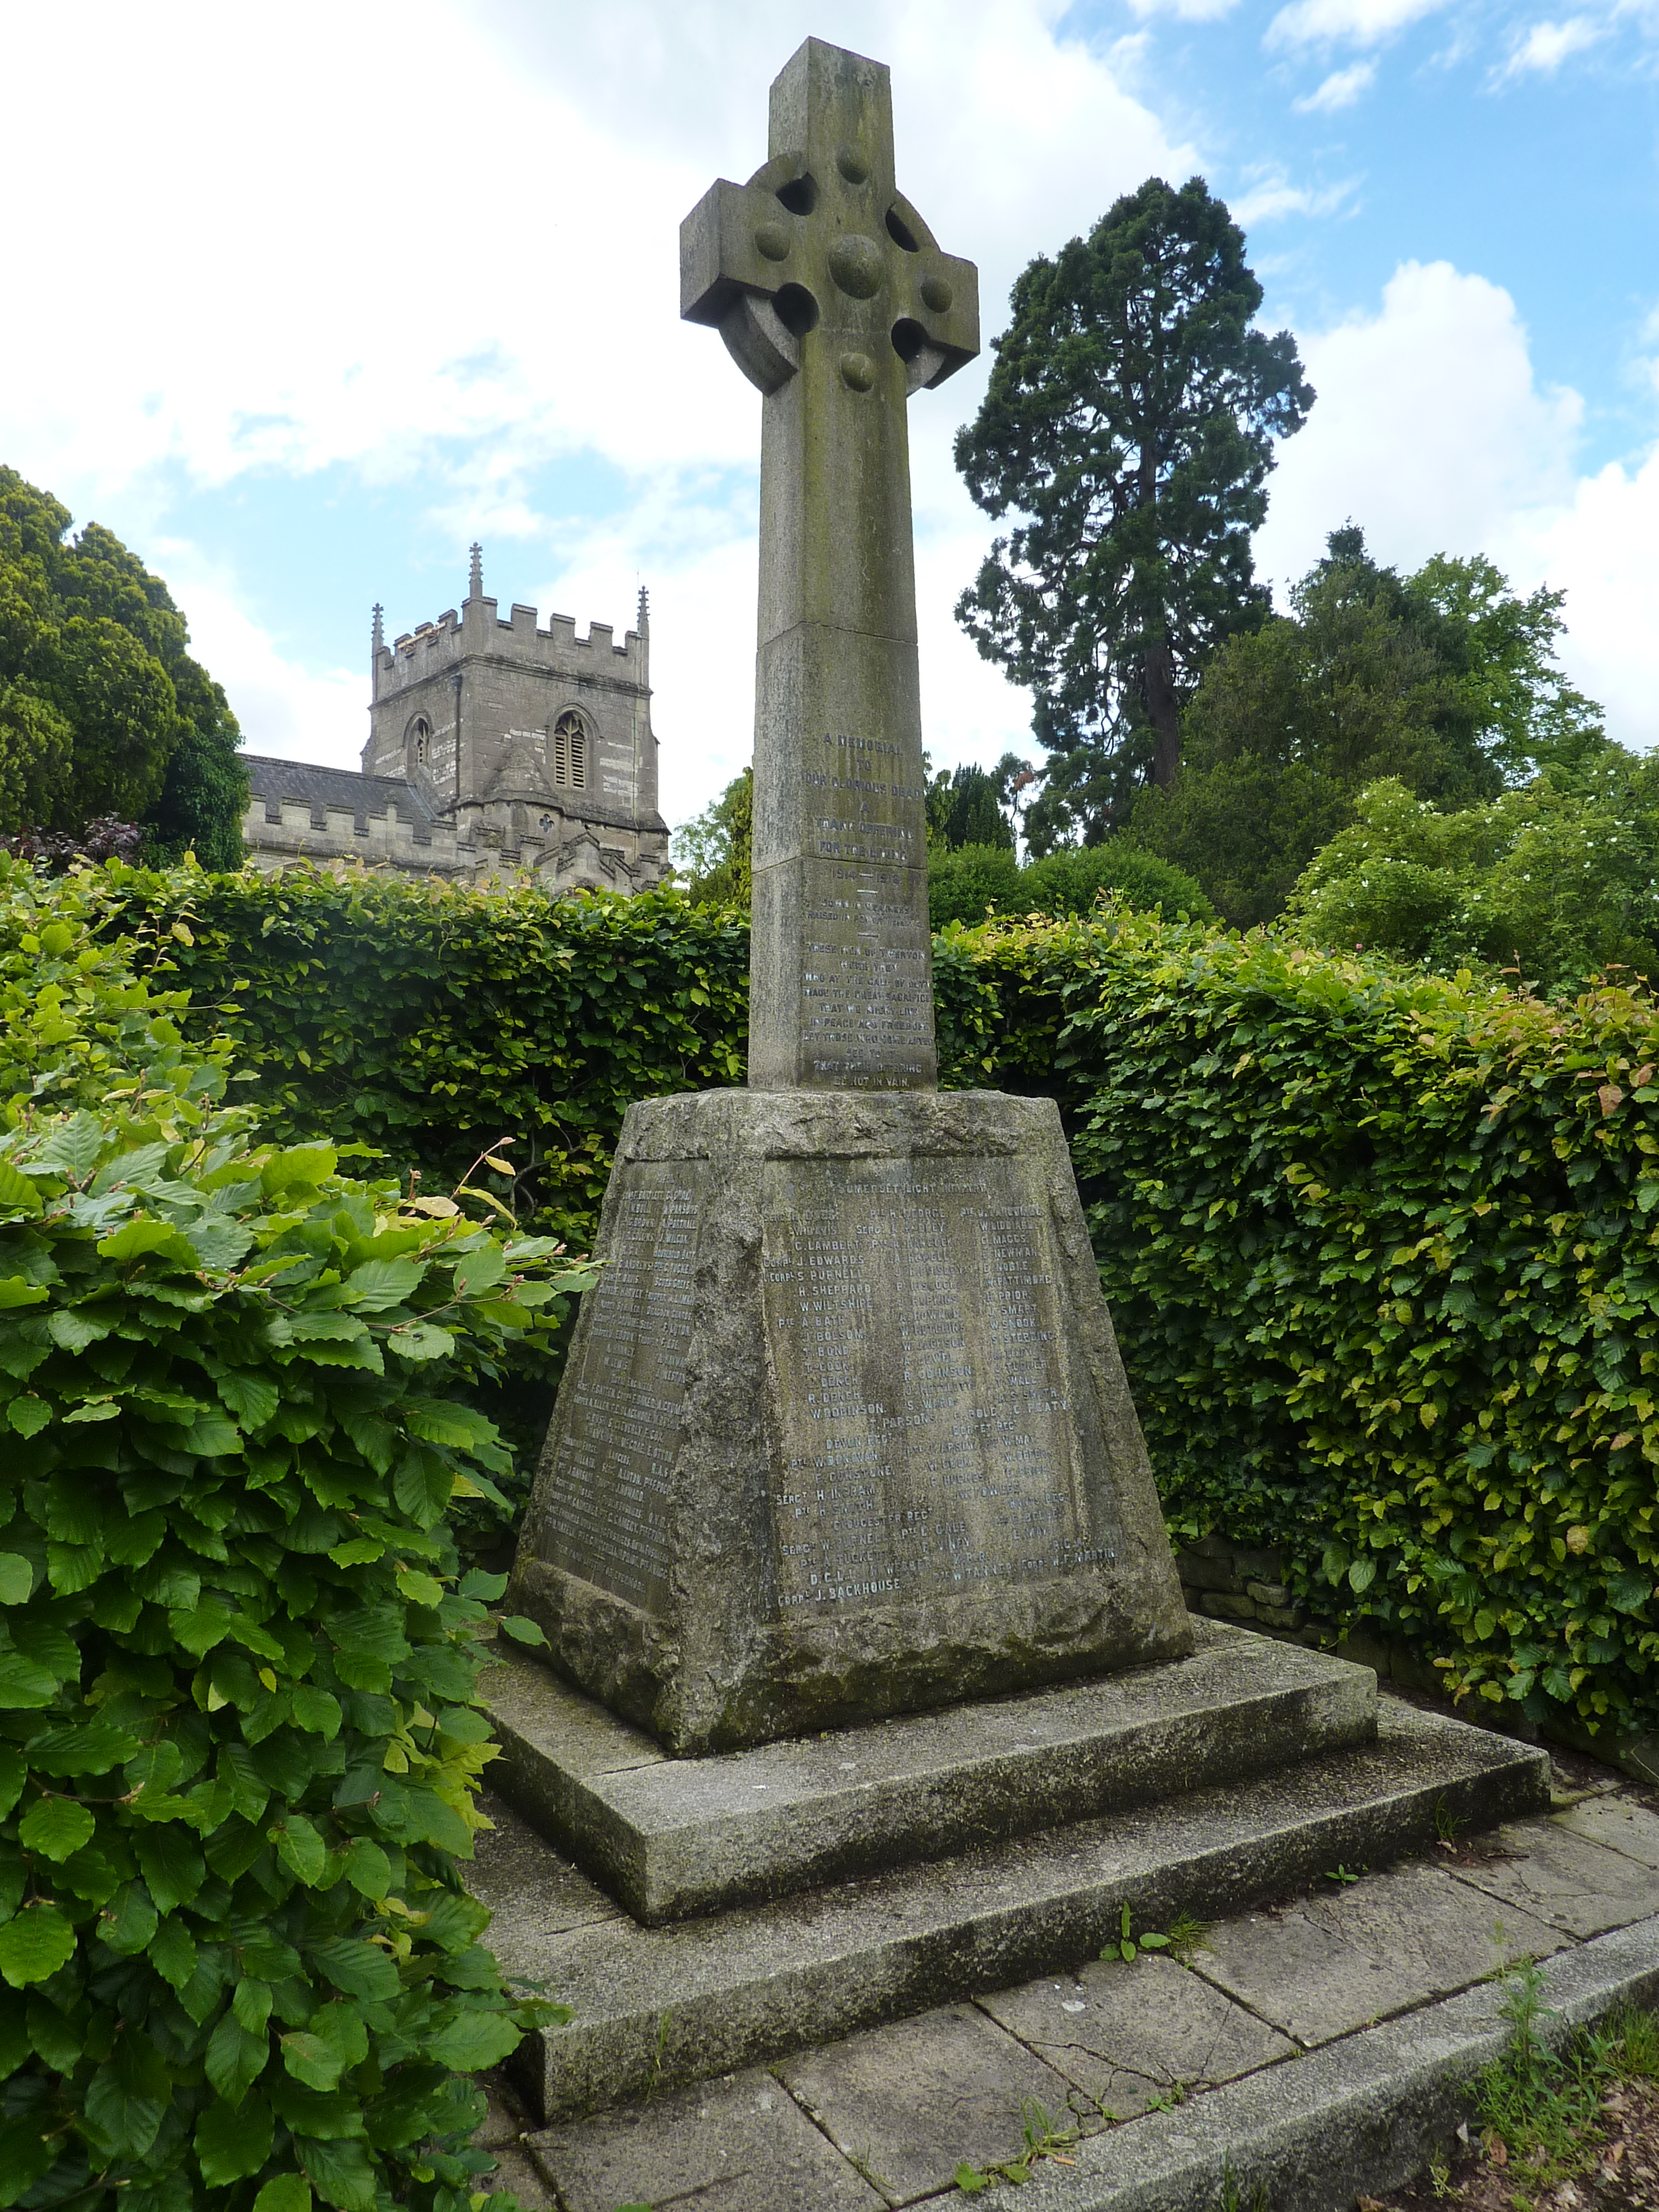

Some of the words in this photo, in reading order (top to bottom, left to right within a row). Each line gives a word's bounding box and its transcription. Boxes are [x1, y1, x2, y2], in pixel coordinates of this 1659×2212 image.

[838, 734, 903, 756] MEMORIAL
[806, 773, 826, 786] OUR
[832, 776, 886, 794] GLORIOUS
[892, 785, 920, 798] DEAD
[860, 821, 913, 839] OFFERING
[819, 841, 840, 853] FOR
[845, 843, 865, 856] THE
[808, 910, 838, 920] RAISED
[806, 943, 836, 954] THESE
[880, 947, 925, 960] TWERTON
[873, 962, 899, 972] THEY
[805, 973, 824, 982] WHO
[846, 976, 863, 985] THE
[833, 989, 850, 998] THE
[855, 990, 882, 1000] GREAT
[886, 991, 930, 1002] SACRIFICE
[819, 1002, 843, 1013] THAT
[824, 1017, 854, 1028] PEACE
[823, 1032, 853, 1042] THOSE
[814, 1060, 839, 1071] THAT
[851, 1077, 869, 1086] NOT
[808, 1241, 860, 1250] LAMBERT
[994, 1247, 1037, 1258] NEWMAN
[809, 1256, 864, 1266] EDWARDS
[811, 1270, 863, 1281] PURNELL
[813, 1284, 871, 1296] SHEPPARD
[813, 1299, 873, 1311] WILTSHIRE
[1002, 1304, 1037, 1315] SMART
[816, 1316, 844, 1326] BATH
[919, 1366, 971, 1379] JOHNSON
[883, 1412, 936, 1429] PARSONS
[1074, 1548, 1115, 1562] MARTIN
[829, 1579, 900, 1599] BACKHOUSE
